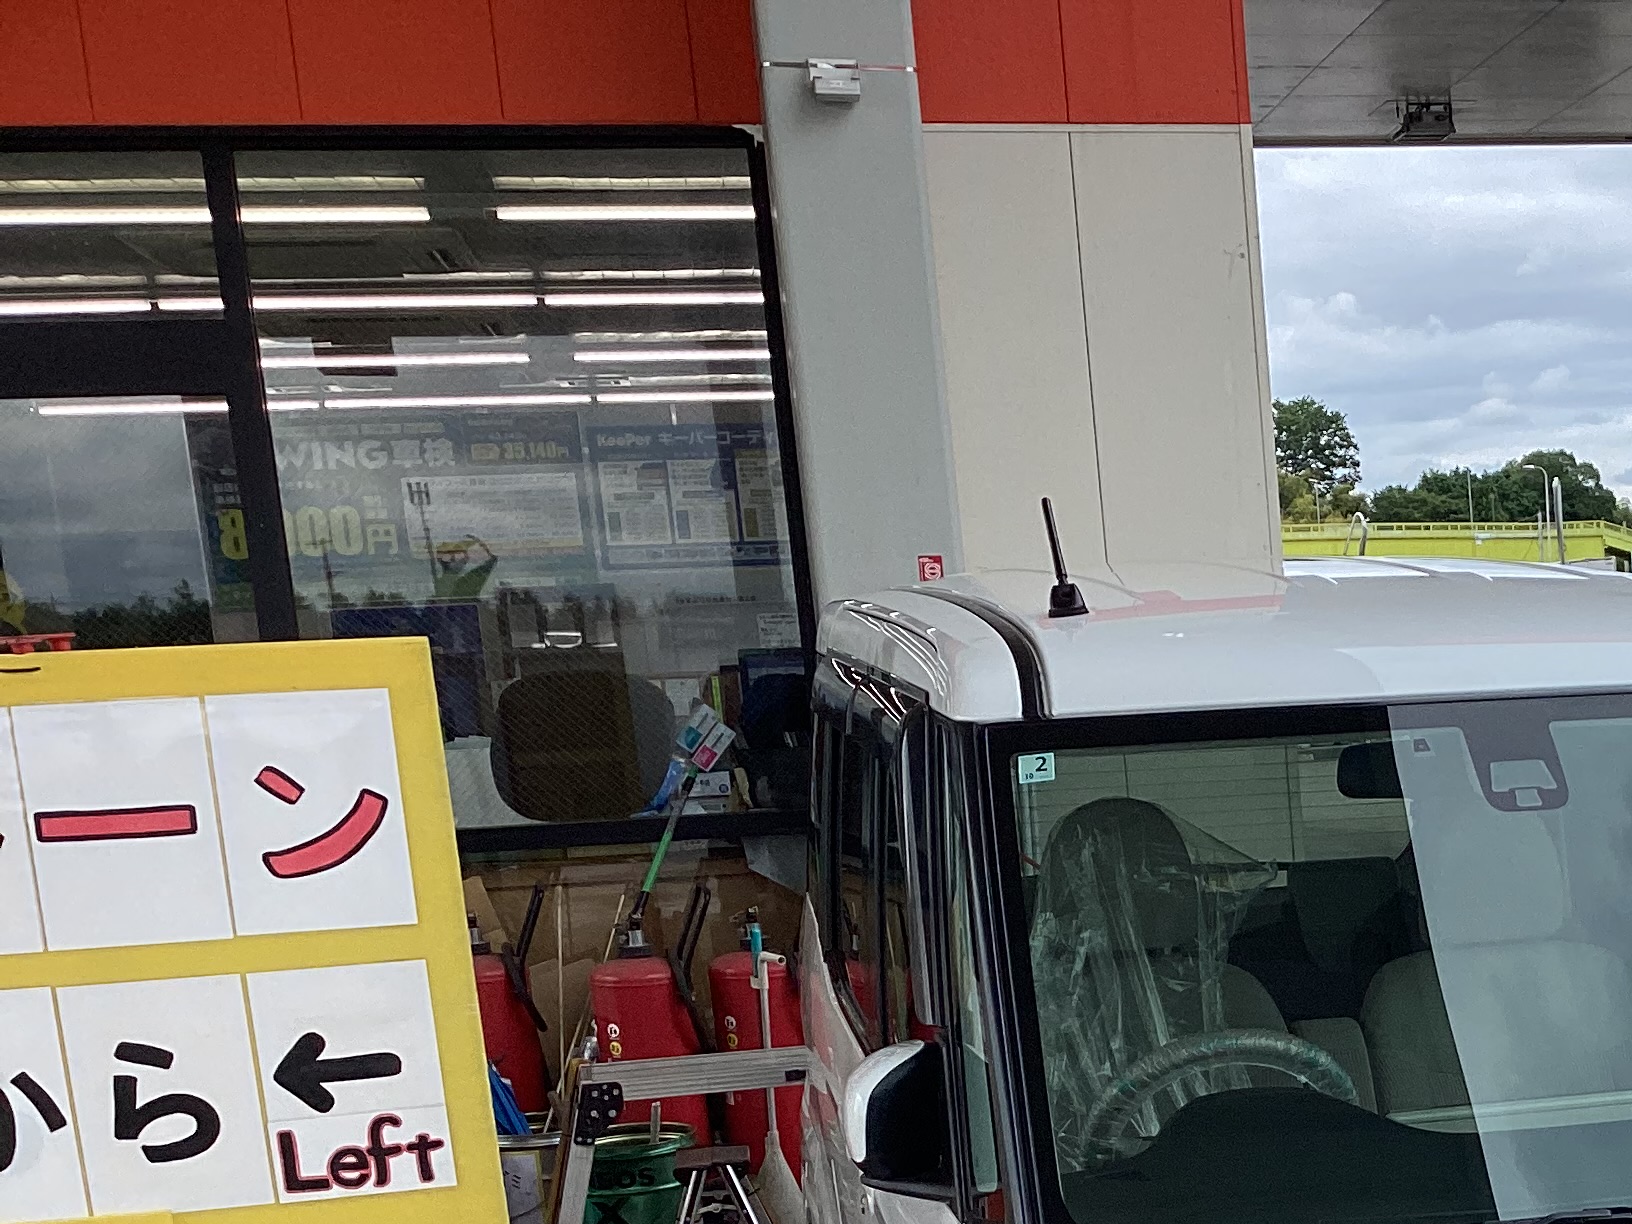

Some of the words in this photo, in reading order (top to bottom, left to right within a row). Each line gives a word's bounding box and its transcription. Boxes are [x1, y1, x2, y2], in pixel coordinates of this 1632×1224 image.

[1035, 756, 1047, 772] 2
[0, 766, 389, 880] ーン
[276, 1113, 445, 1194] Left
